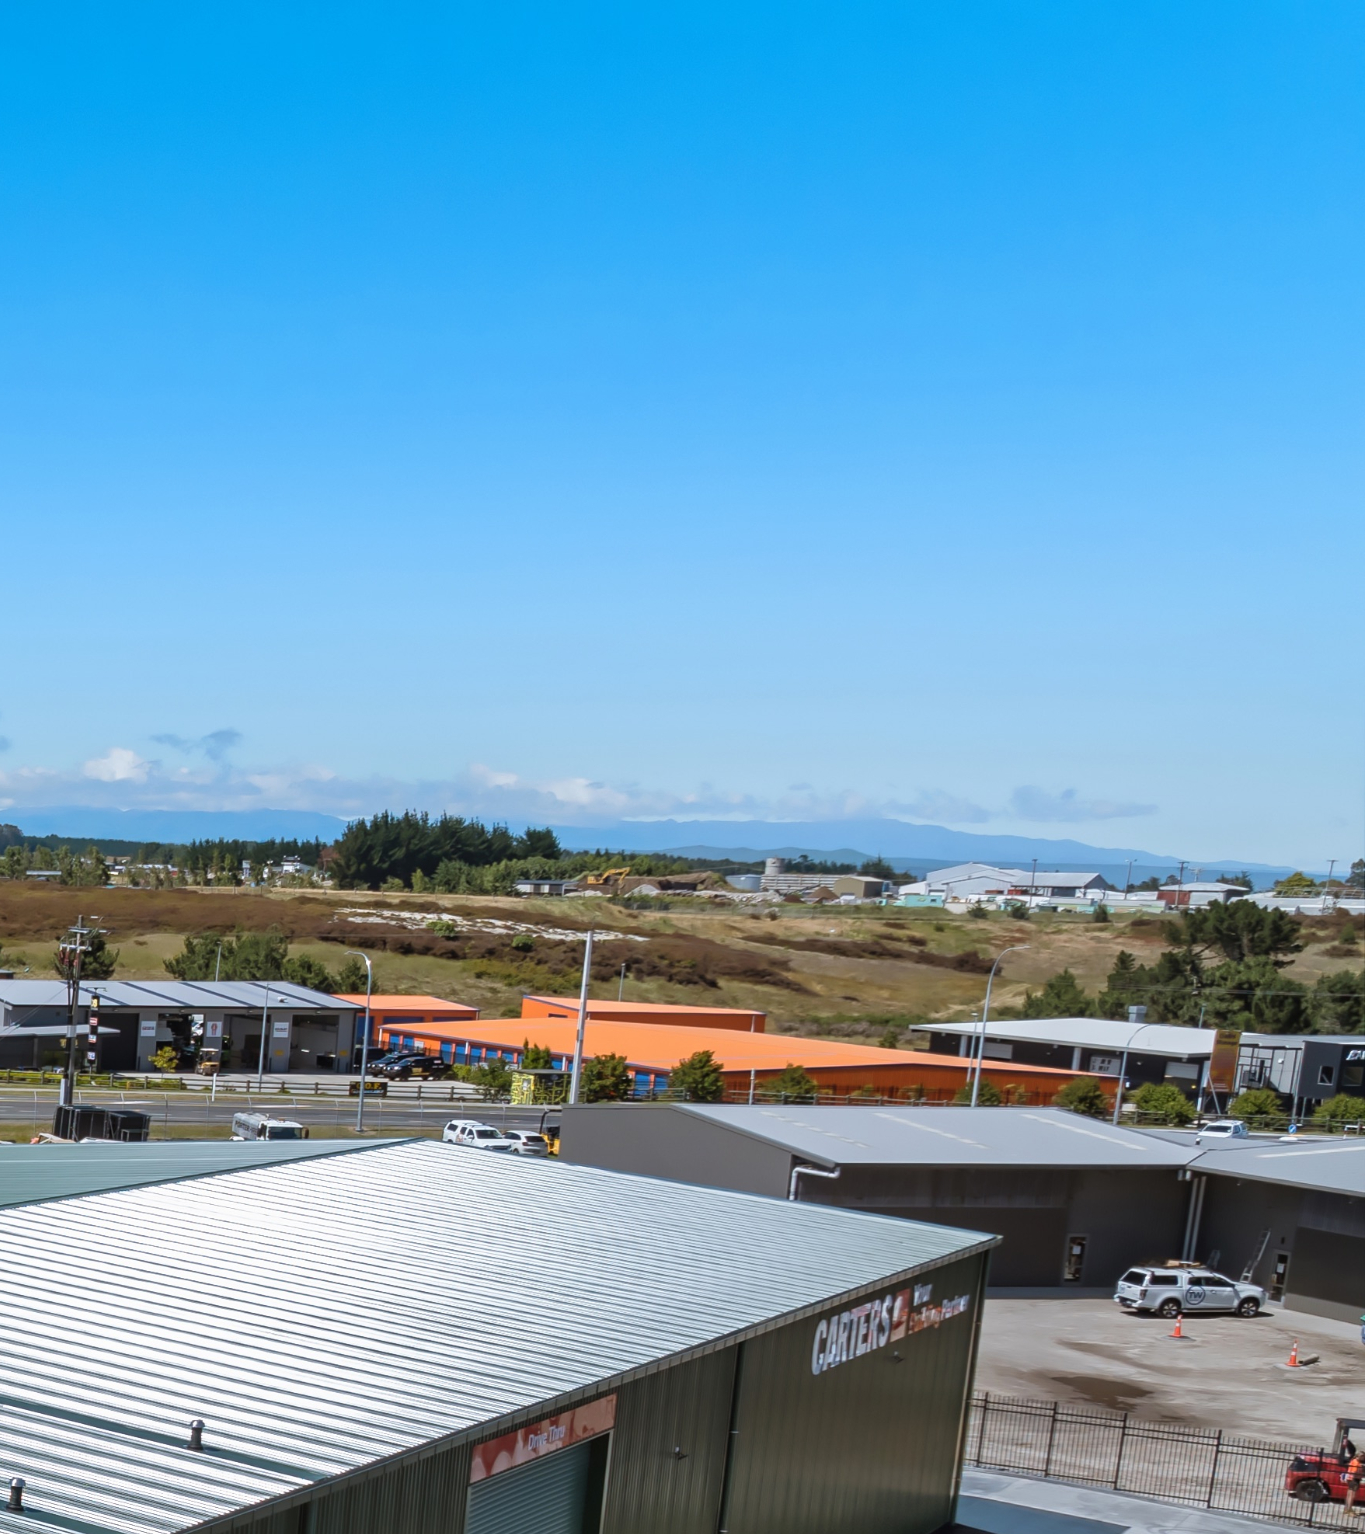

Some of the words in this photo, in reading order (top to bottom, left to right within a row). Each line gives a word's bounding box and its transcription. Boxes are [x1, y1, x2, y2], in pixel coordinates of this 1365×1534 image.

[1188, 1291, 1203, 1299] TW
[811, 1294, 893, 1376] CARTERS
[527, 1432, 548, 1451] Drive
[549, 1424, 566, 1443] Thru
